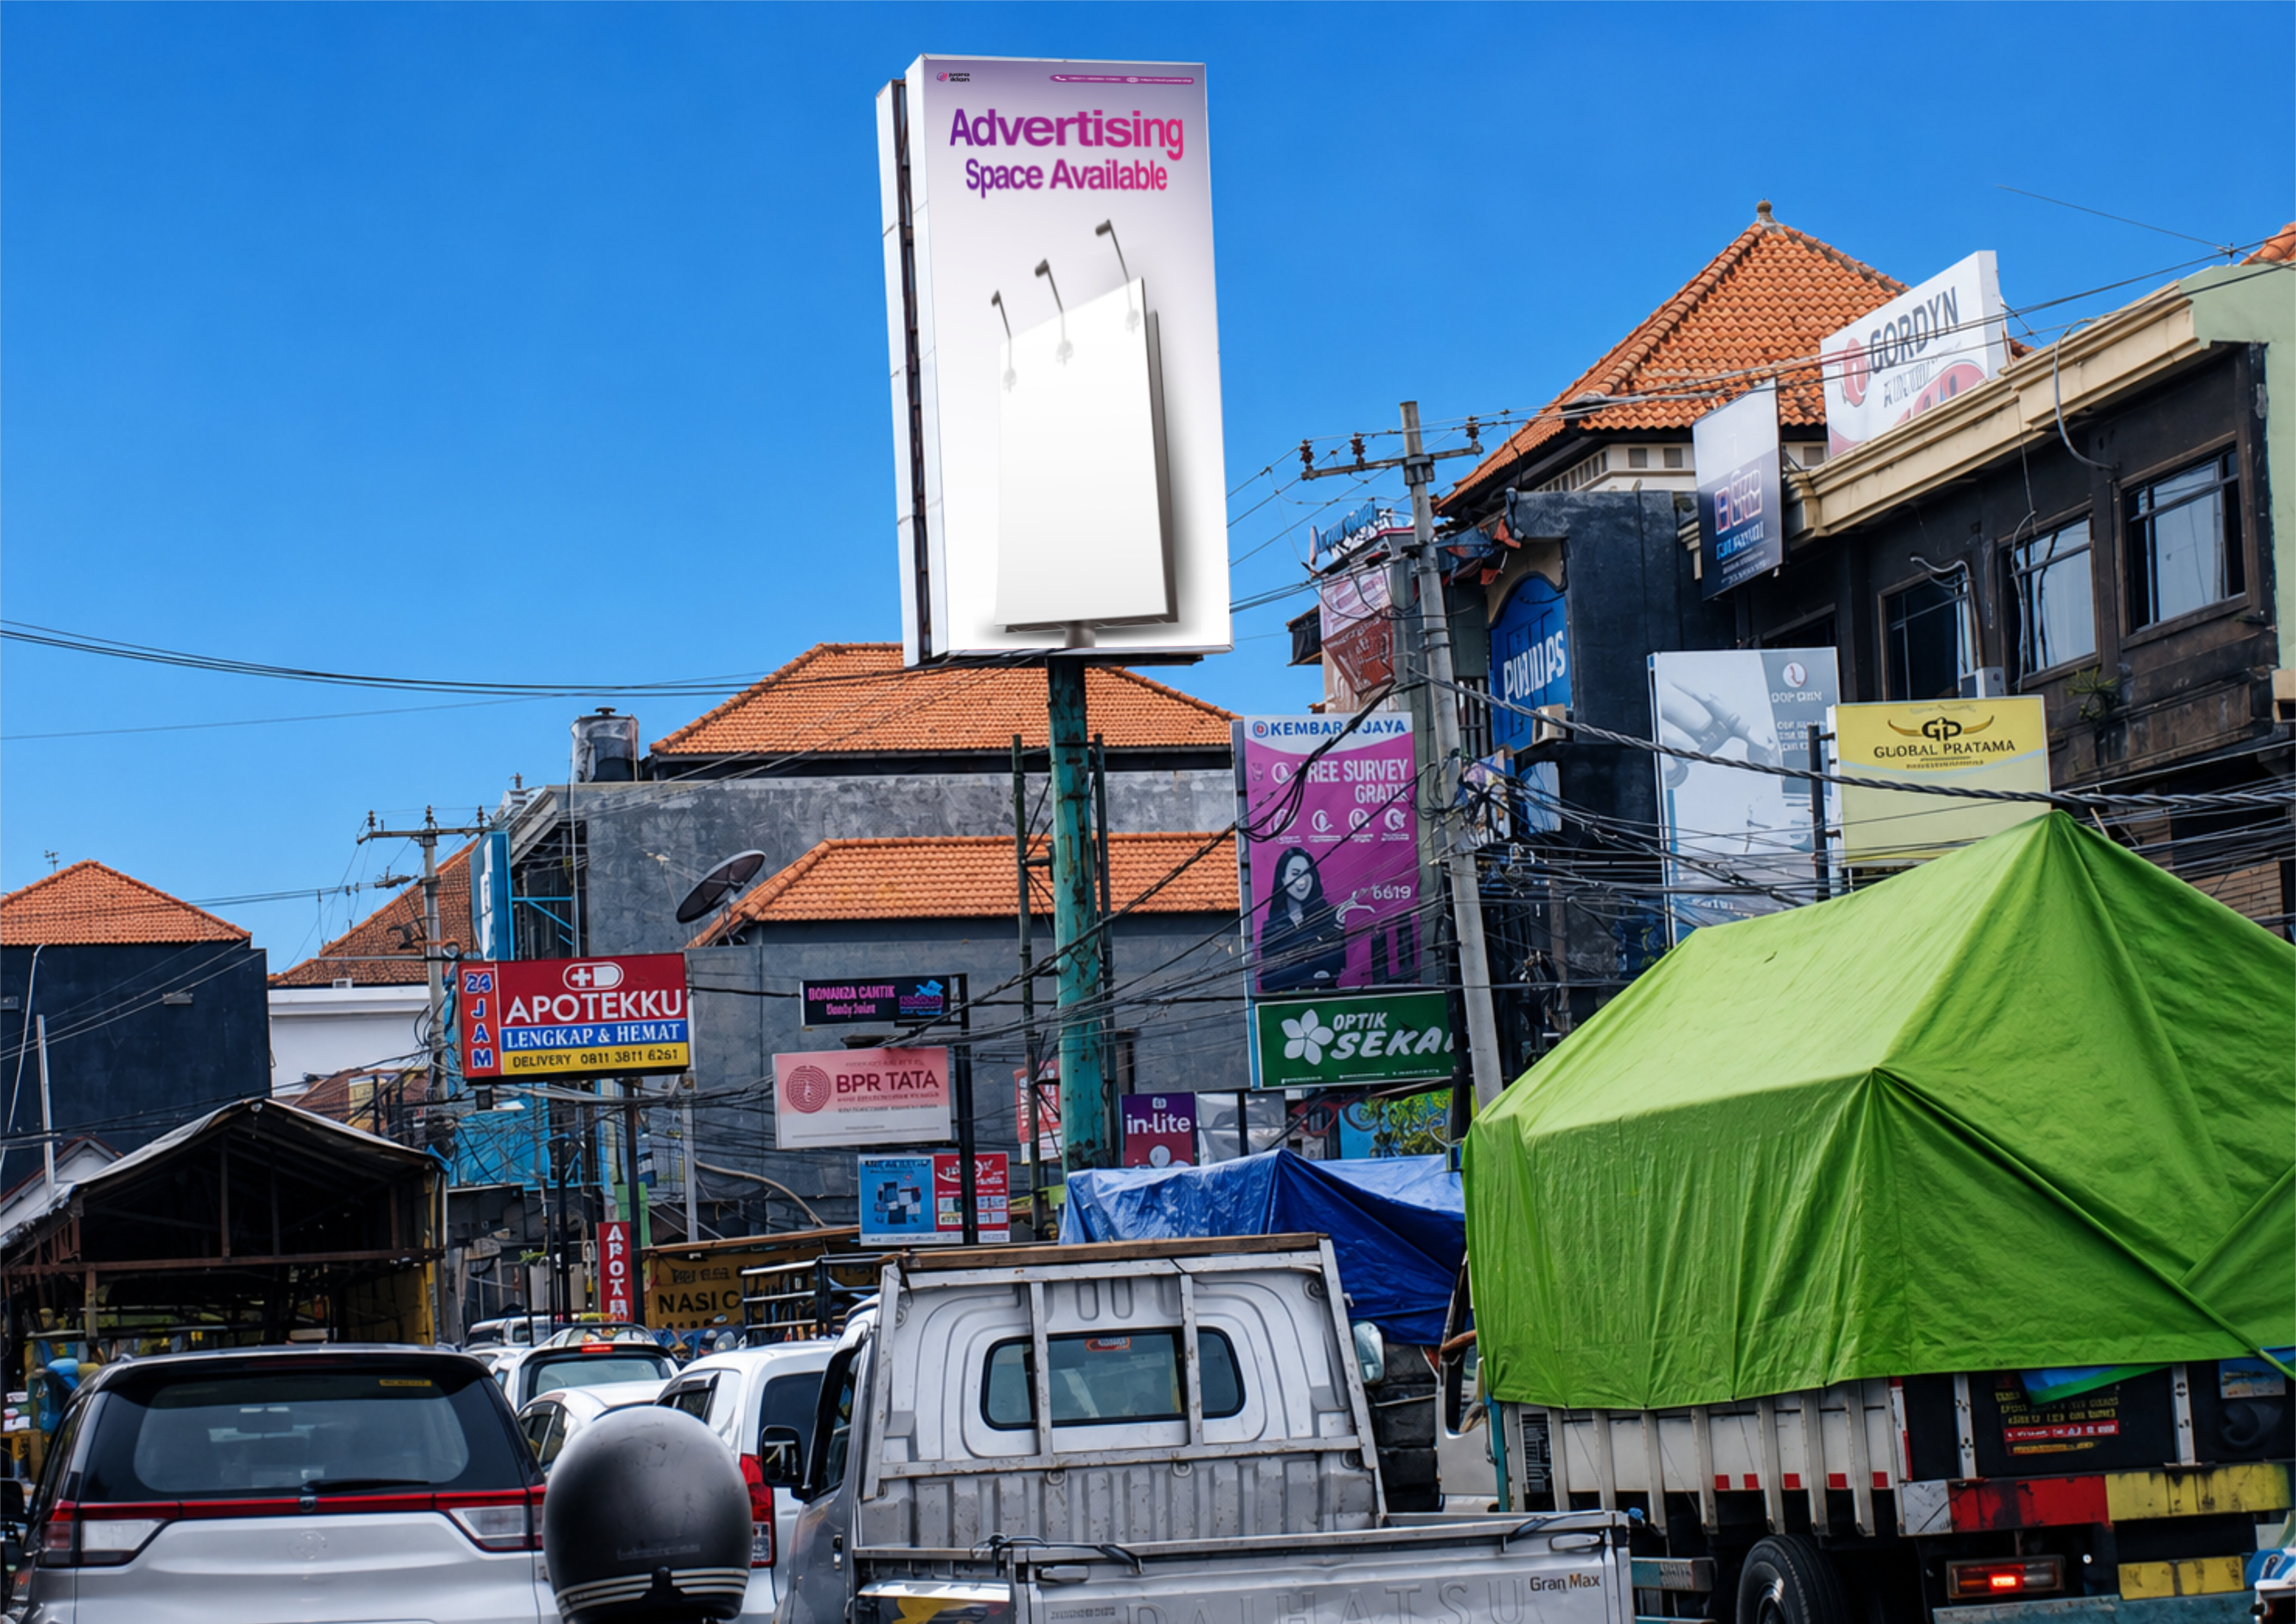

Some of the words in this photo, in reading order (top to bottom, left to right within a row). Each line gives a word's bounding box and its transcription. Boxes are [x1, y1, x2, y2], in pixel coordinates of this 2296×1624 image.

[950, 108, 1183, 161] Advertising
[966, 158, 1044, 199] Space
[1049, 158, 1168, 191] Available
[1270, 720, 1356, 736] KEMBAR
[1362, 718, 1406, 733] JAYA
[1944, 739, 2016, 755] PRATAMA
[1297, 761, 1340, 783] REE
[1343, 759, 1408, 782] SURVEY
[464, 973, 493, 994] 24
[504, 989, 682, 1024] APOTEKKU
[1332, 1012, 1388, 1031] OPTIK
[507, 1027, 593, 1048] LENGKAP
[597, 1027, 610, 1043] &
[616, 1024, 680, 1042] HEMAT
[512, 1054, 572, 1068] DELIVERY
[836, 1073, 881, 1093] BPR
[885, 1069, 940, 1090] TATA
[658, 1291, 717, 1314] NASI
[1530, 1576, 1567, 1592] Gran
[1568, 1573, 1600, 1588] Max
